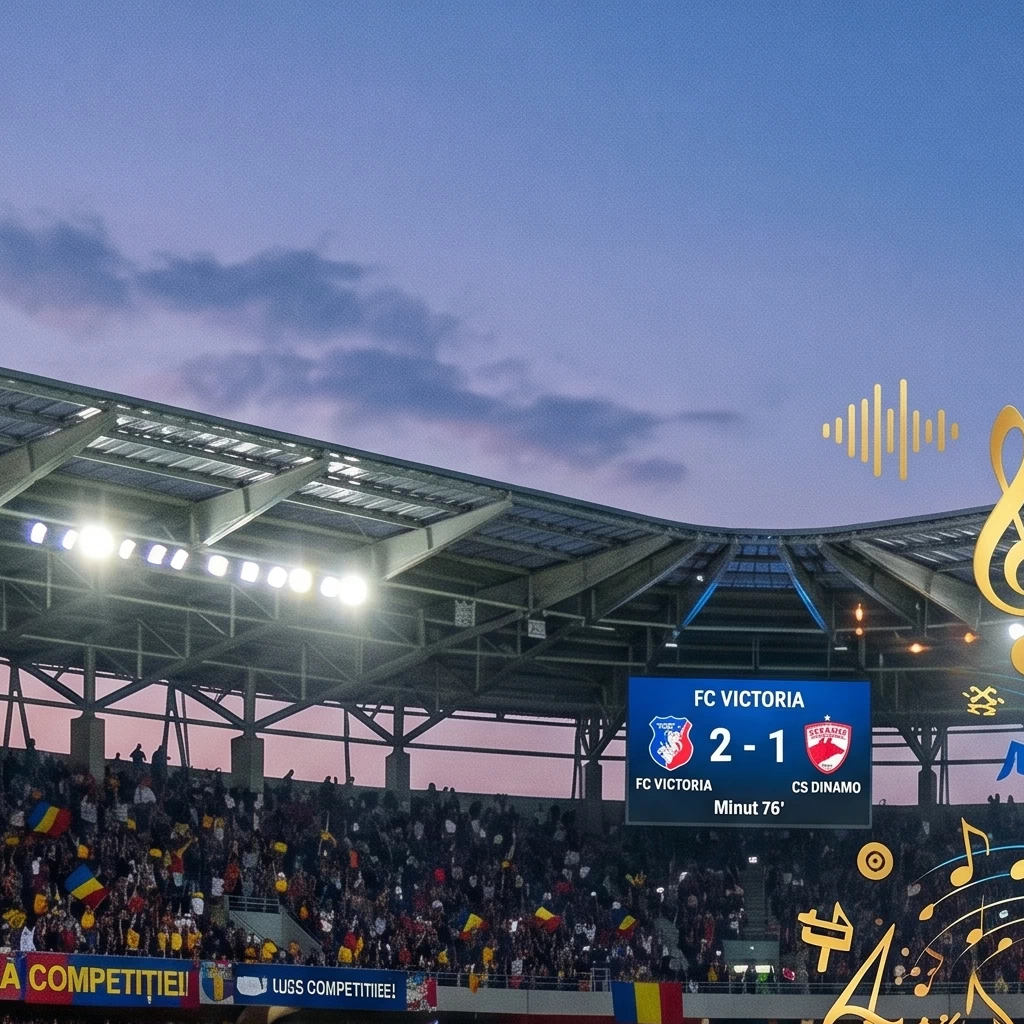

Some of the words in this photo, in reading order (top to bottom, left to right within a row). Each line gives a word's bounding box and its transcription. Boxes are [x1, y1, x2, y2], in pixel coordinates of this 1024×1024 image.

[694, 690, 716, 707] FC
[721, 690, 805, 708] VICTORIA
[709, 727, 732, 762] 2
[769, 729, 784, 763] 1
[635, 778, 651, 790] FC
[654, 778, 713, 792] VICTORIA
[791, 780, 809, 794] CS
[811, 781, 862, 794] DINAMO
[714, 800, 759, 815] Minut
[762, 801, 785, 815] 76'
